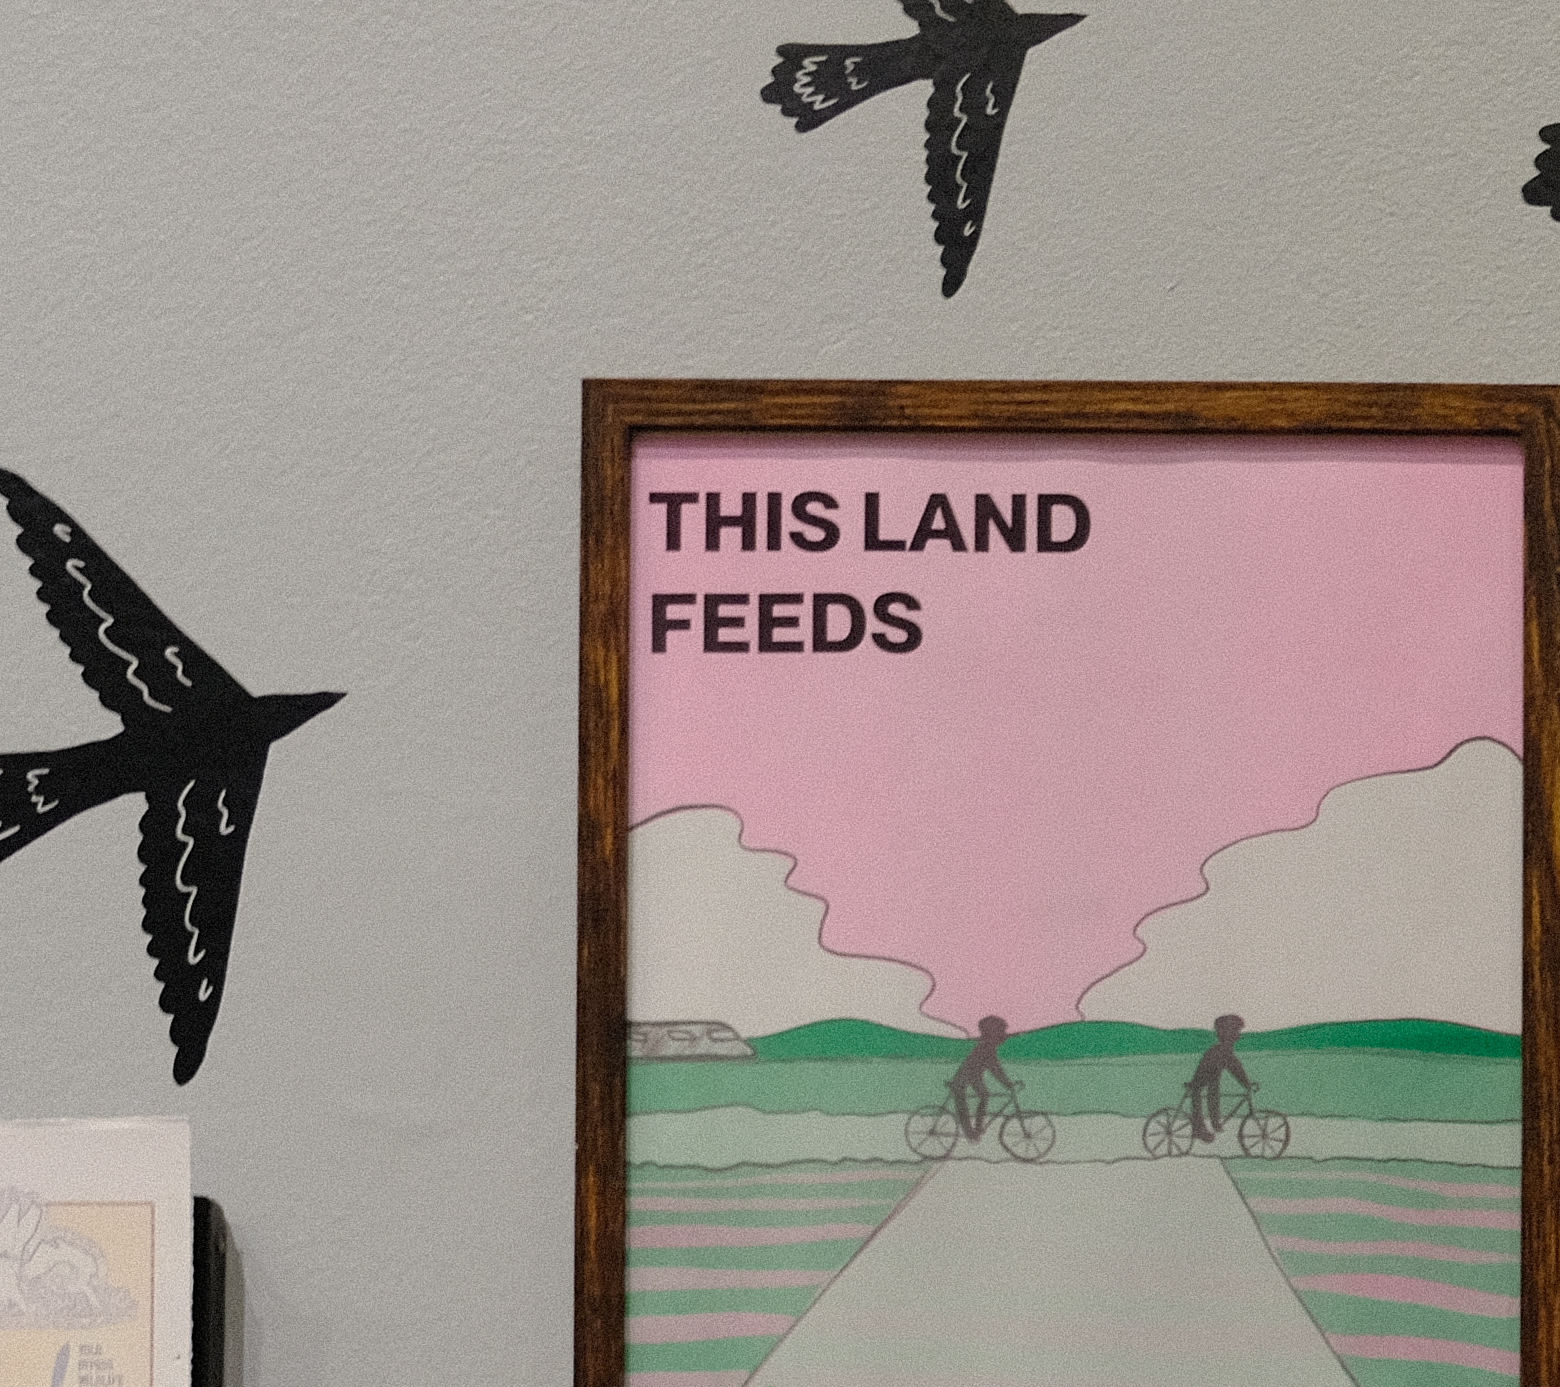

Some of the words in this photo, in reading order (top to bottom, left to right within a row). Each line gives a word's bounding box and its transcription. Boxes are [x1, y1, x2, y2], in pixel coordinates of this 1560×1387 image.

[649, 491, 840, 552] THIS
[864, 492, 1090, 553] LAND
[652, 592, 922, 653] FEEDS
